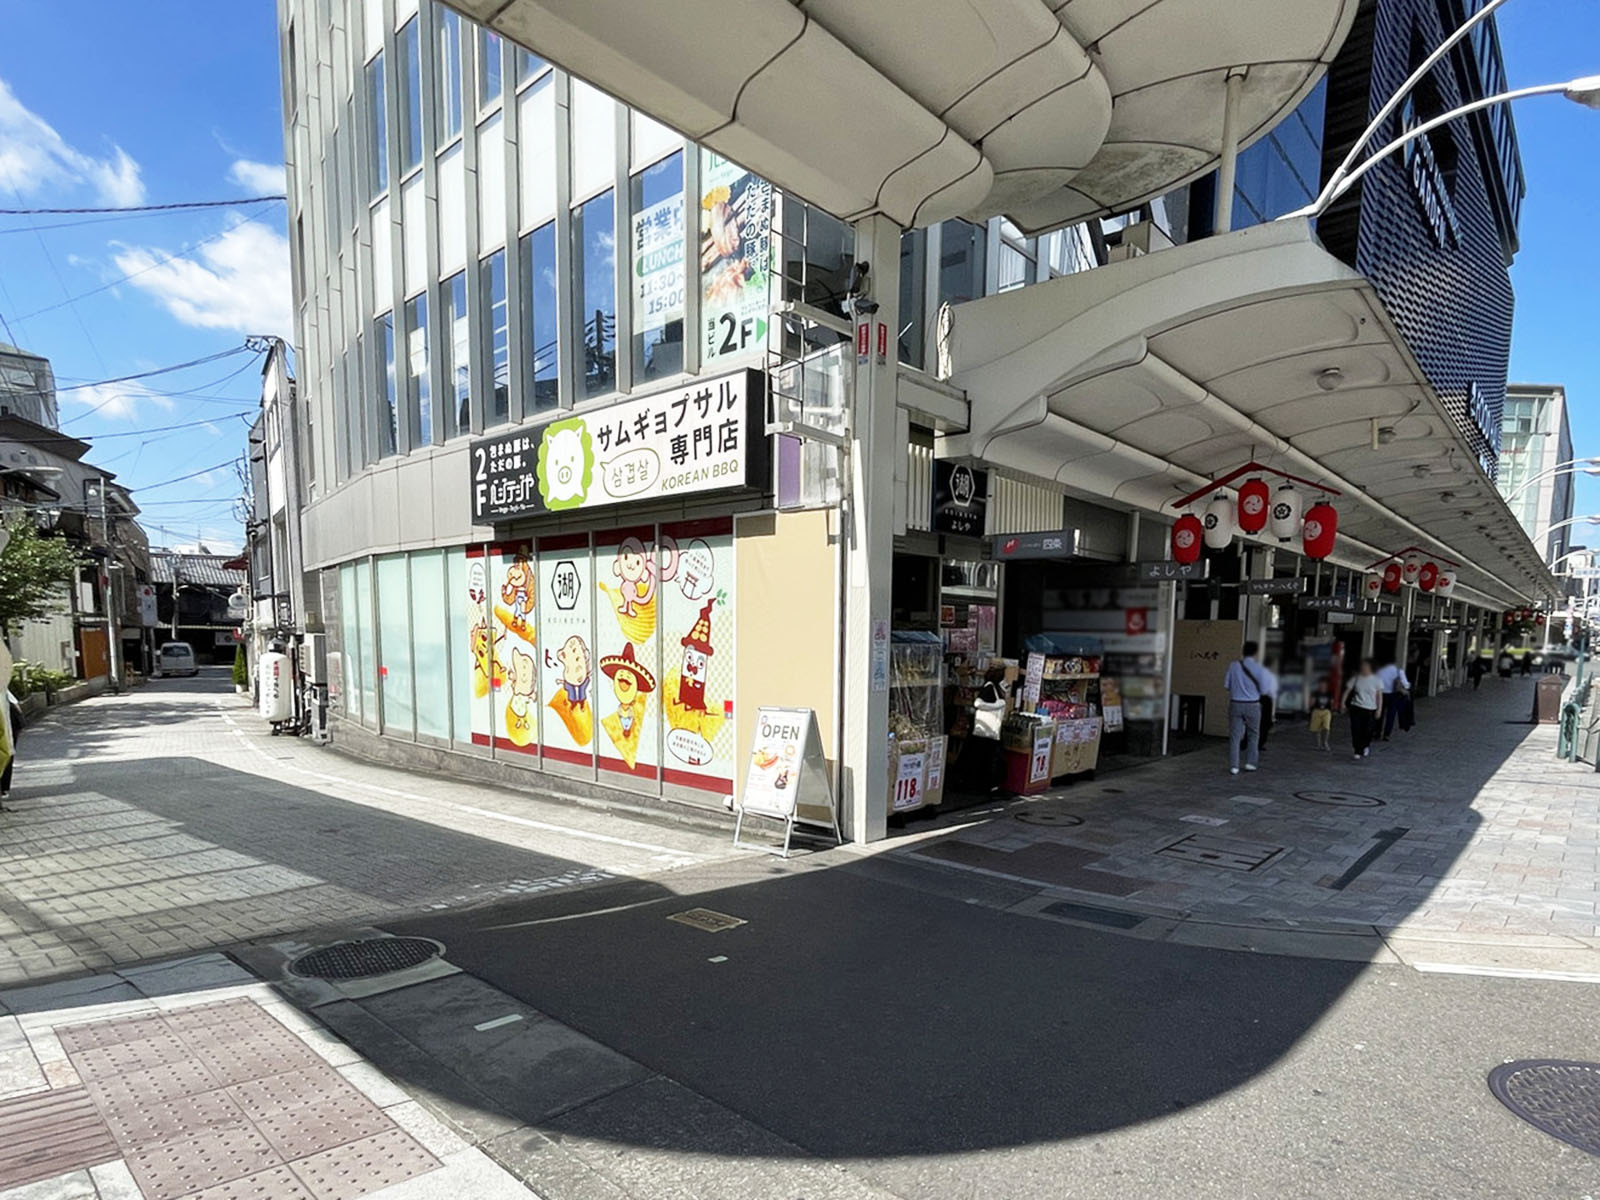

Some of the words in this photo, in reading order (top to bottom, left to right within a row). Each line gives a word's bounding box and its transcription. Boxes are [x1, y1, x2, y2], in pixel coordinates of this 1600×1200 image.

[719, 311, 753, 356] 2F
[597, 381, 737, 452] サムギョプサル
[670, 418, 738, 465] 専門店
[612, 459, 648, 488] 삼겹살
[661, 467, 710, 491] KOREAN
[712, 459, 739, 478] BBQ
[1150, 564, 1191, 577] よしや
[558, 572, 574, 599] 湖
[762, 724, 800, 740] OPEN
[897, 777, 917, 801] 118
